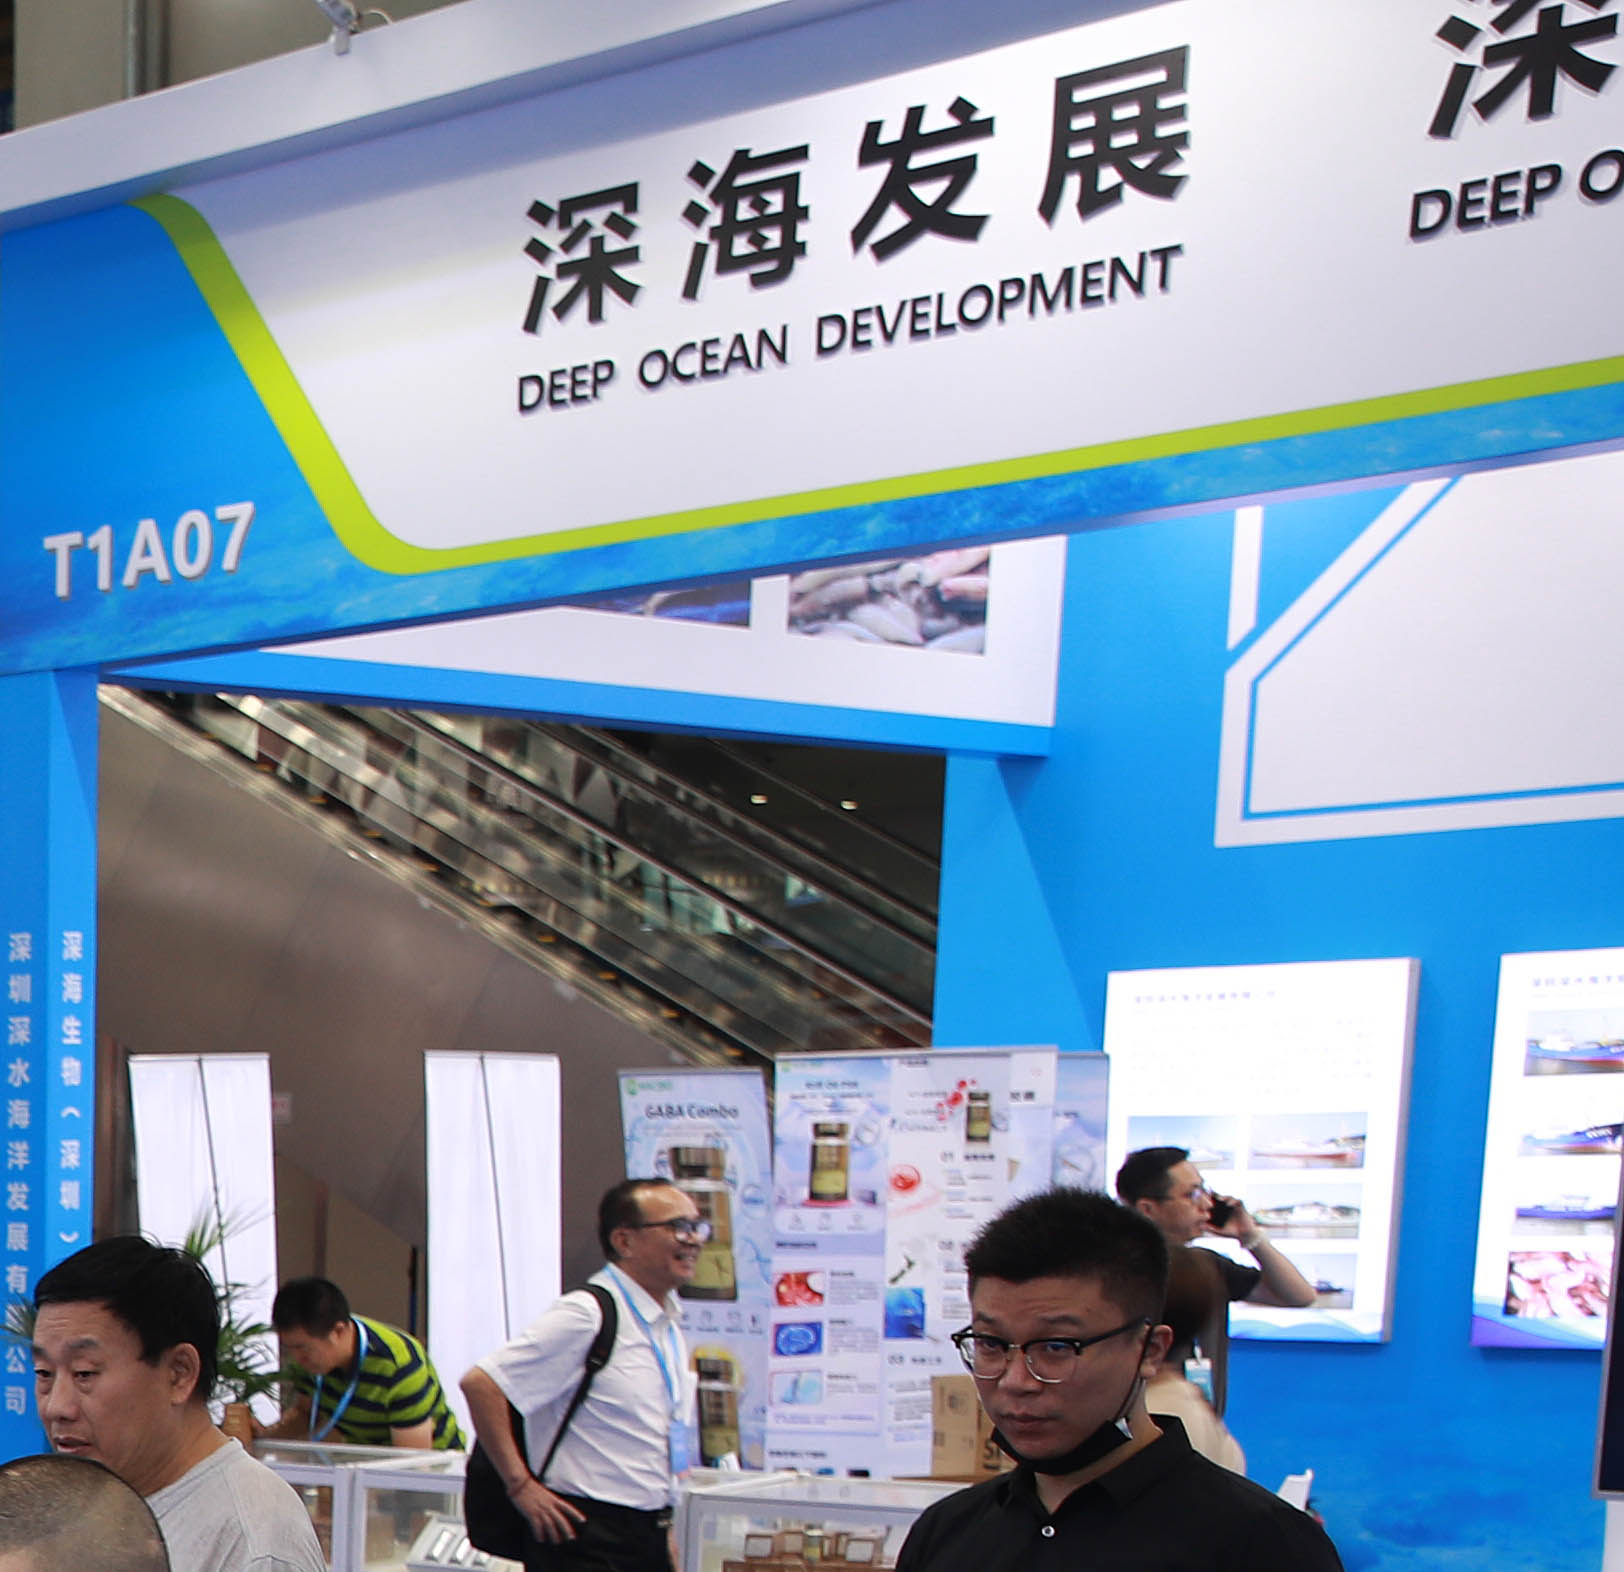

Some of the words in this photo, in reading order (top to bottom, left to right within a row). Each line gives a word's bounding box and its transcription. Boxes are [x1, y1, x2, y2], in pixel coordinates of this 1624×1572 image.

[523, 44, 1190, 335] 深海发展
[1409, 163, 1563, 243] DEEP
[518, 359, 616, 415] DEEP
[639, 324, 788, 390] OCEAN
[816, 244, 1184, 359] DEVELOPMENT
[43, 500, 255, 600] T1A07
